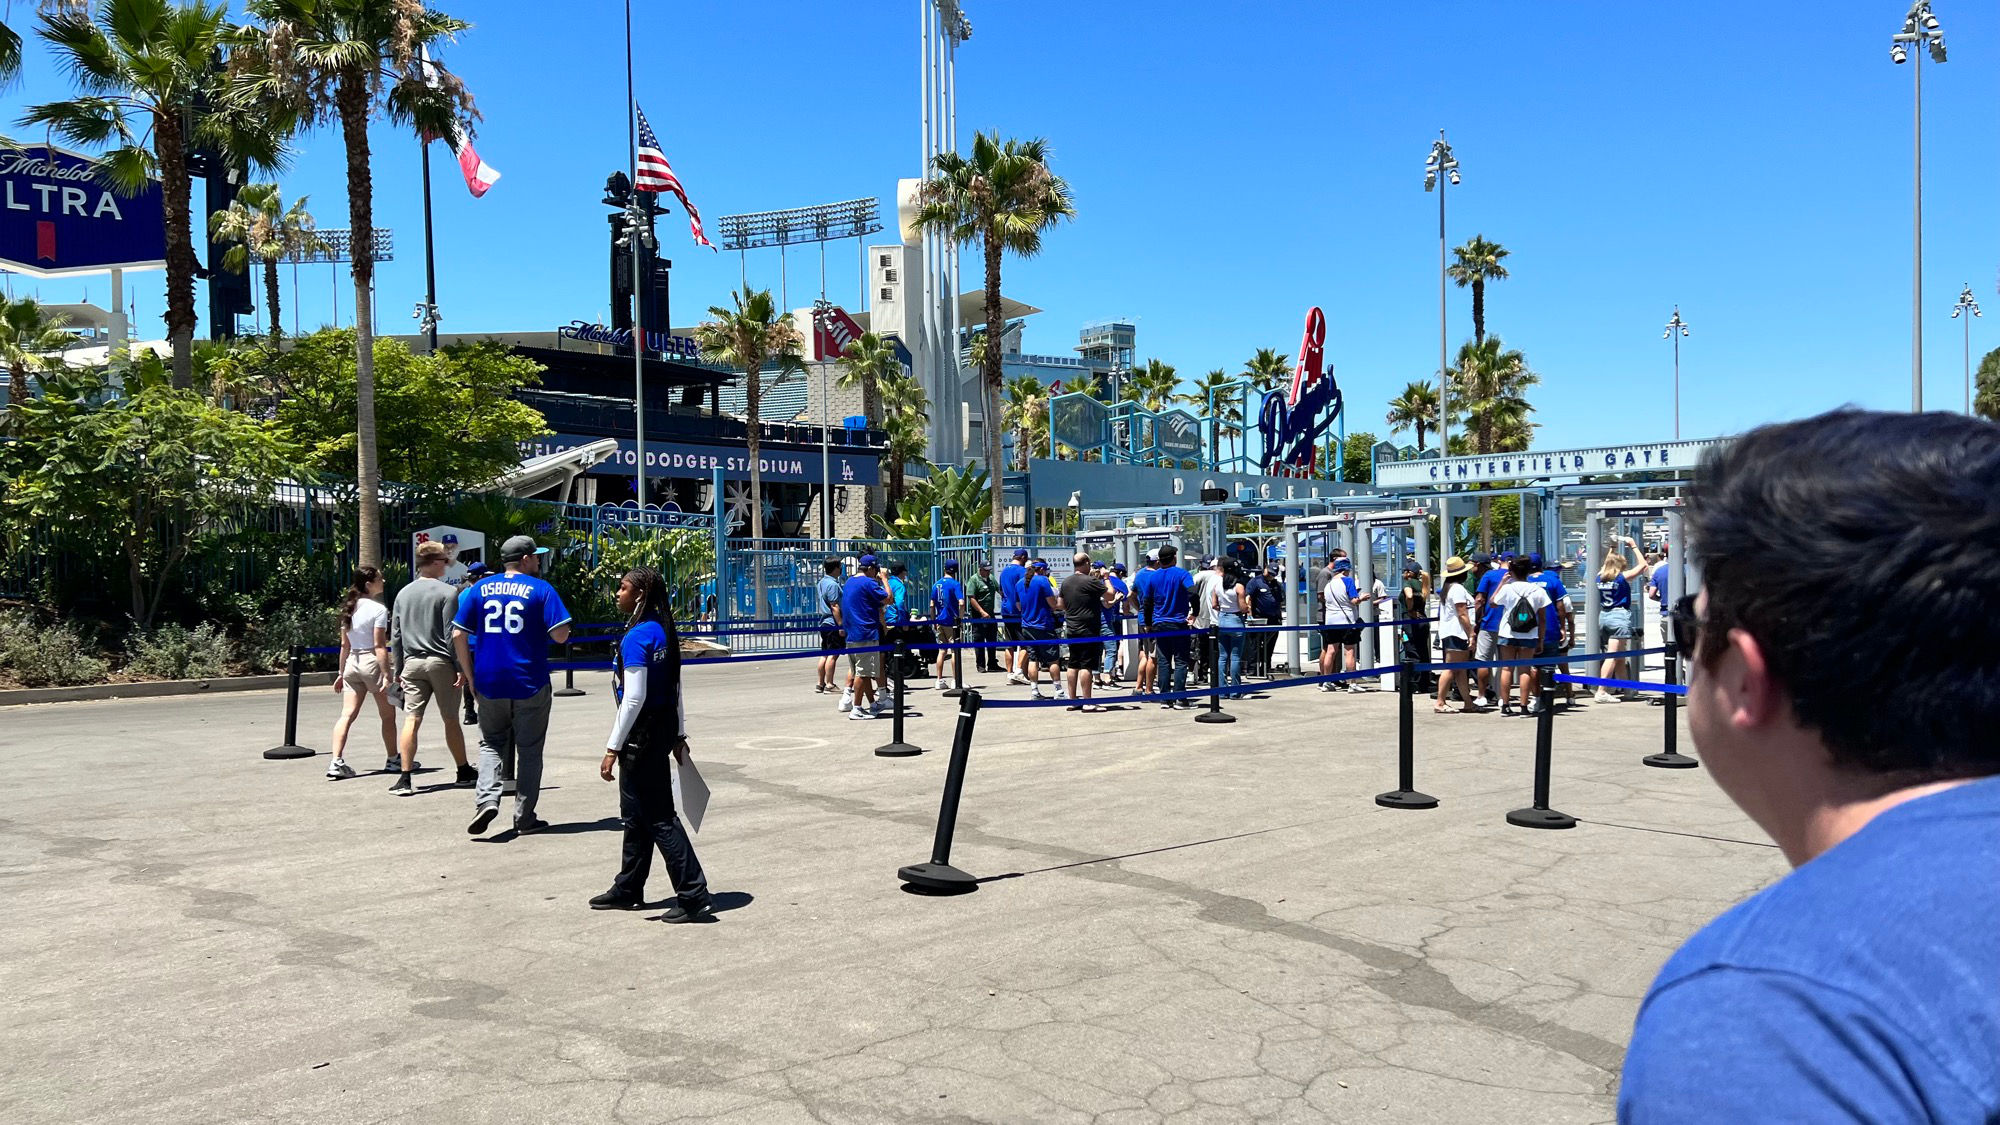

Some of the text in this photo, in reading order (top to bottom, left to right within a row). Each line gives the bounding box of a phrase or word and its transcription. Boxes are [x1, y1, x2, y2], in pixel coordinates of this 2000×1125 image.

[0, 153, 97, 182] Michelob
[646, 330, 702, 357] ULTR
[615, 450, 637, 465] TO
[646, 451, 718, 469] DODGER
[841, 459, 854, 481] LA
[1429, 449, 1669, 478] CENTERFIELD GATE
[1674, 498, 1681, 506] 5
[480, 582, 534, 600] OSBORNE
[1602, 590, 1614, 607] 5
[483, 599, 525, 635] 26
